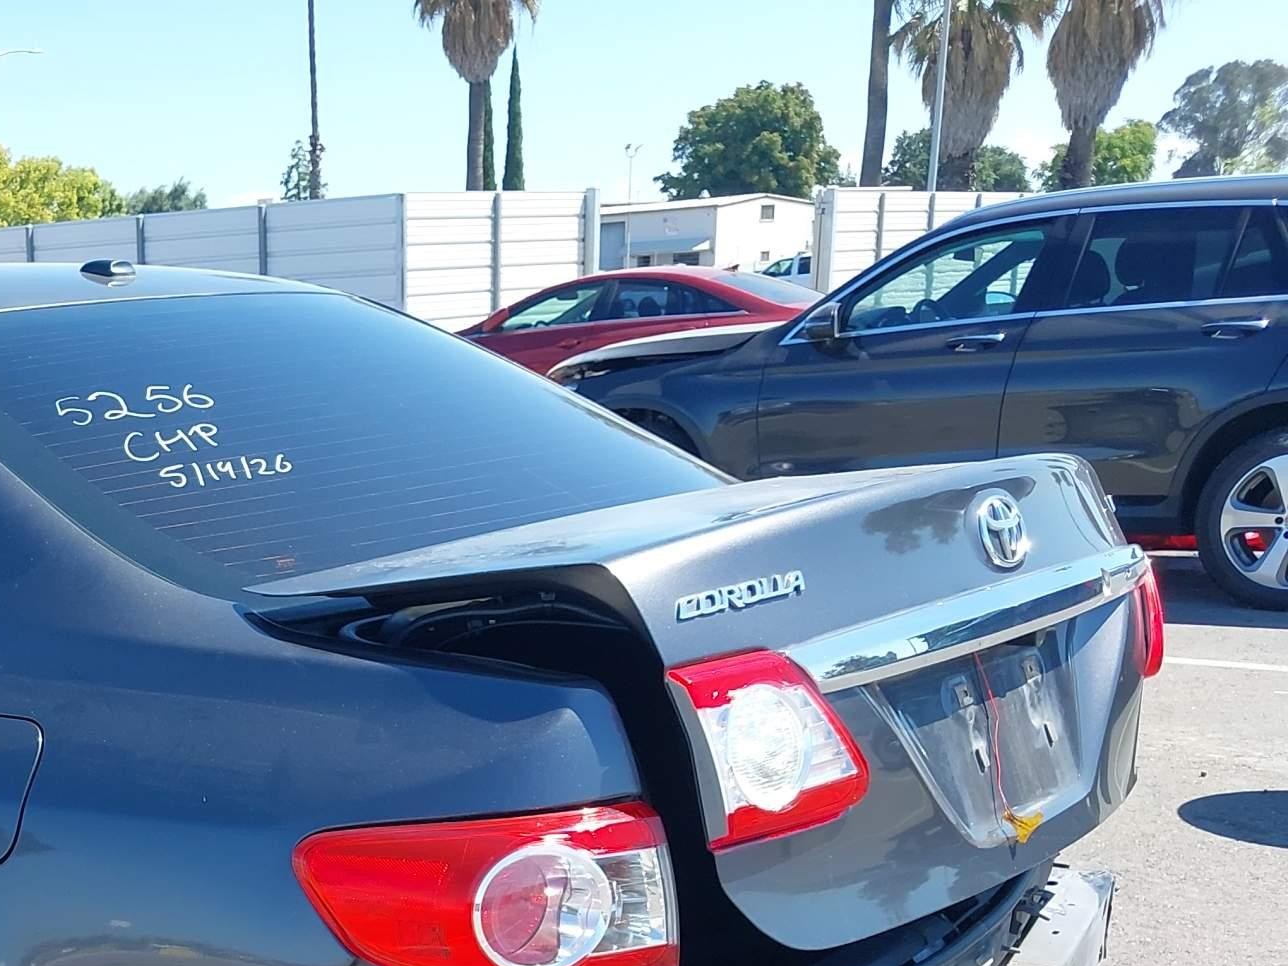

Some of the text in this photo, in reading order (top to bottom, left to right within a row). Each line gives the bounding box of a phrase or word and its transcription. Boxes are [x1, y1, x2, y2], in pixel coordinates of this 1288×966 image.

[54, 382, 216, 427] 5256
[122, 421, 220, 463] CHP
[158, 452, 294, 489] 5/19/26
[675, 569, 807, 623] COROLLA
